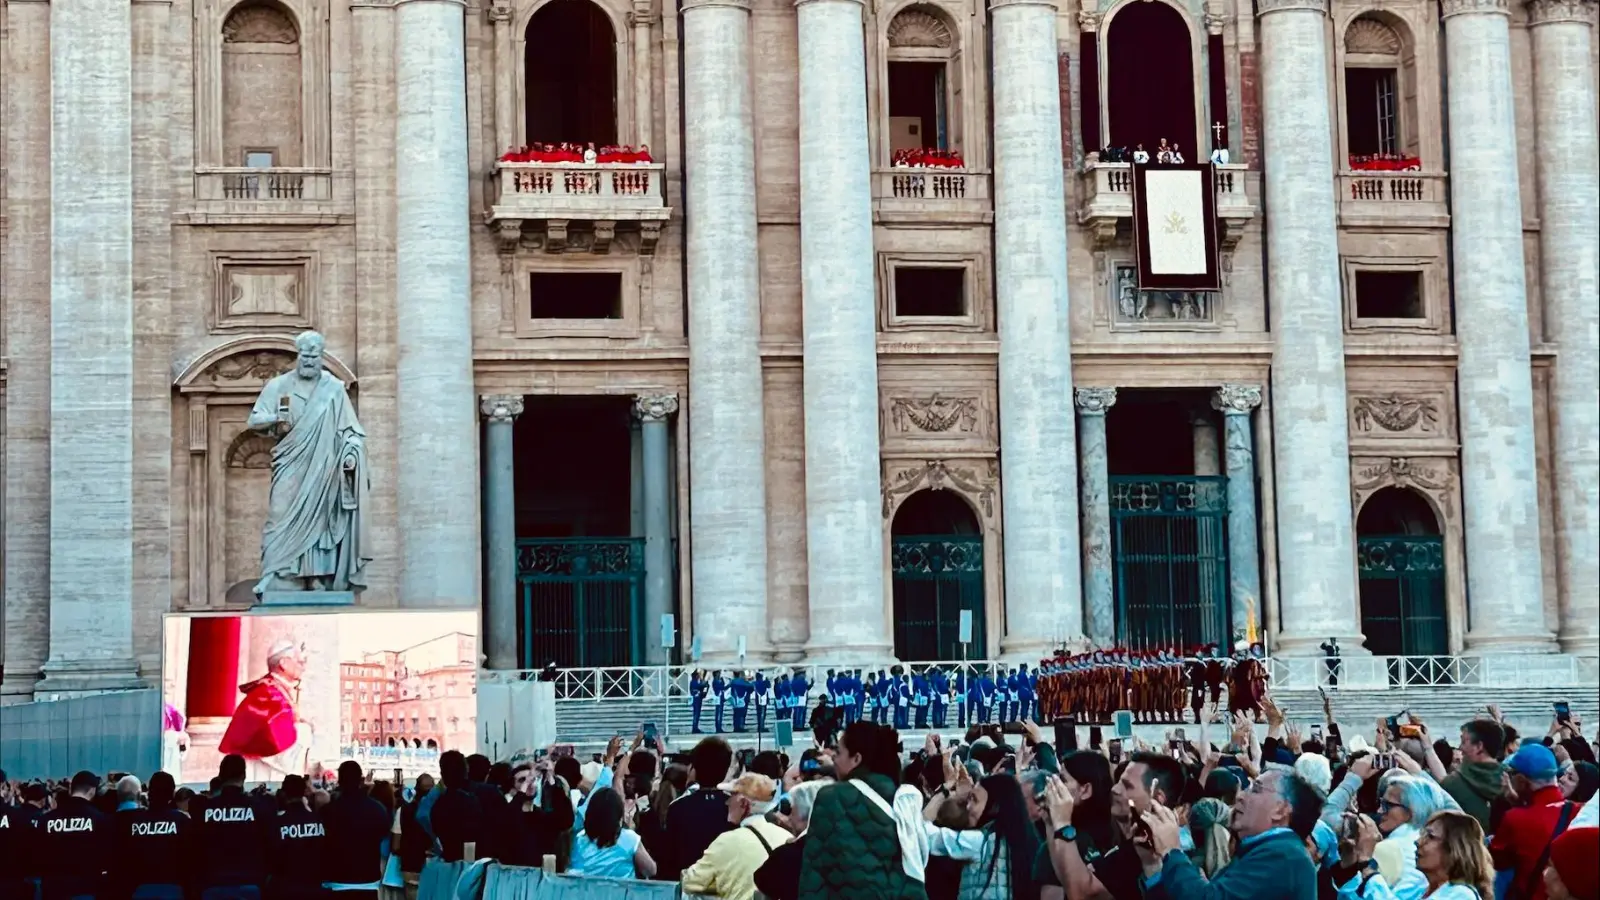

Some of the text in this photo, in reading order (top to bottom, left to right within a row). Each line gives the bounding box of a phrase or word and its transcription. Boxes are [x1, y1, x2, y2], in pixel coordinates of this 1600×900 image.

[204, 807, 254, 822] POLIZIA
[47, 817, 92, 833] POLIZIA
[131, 821, 177, 836] POLIZIA
[280, 822, 325, 839] POLIZIA
